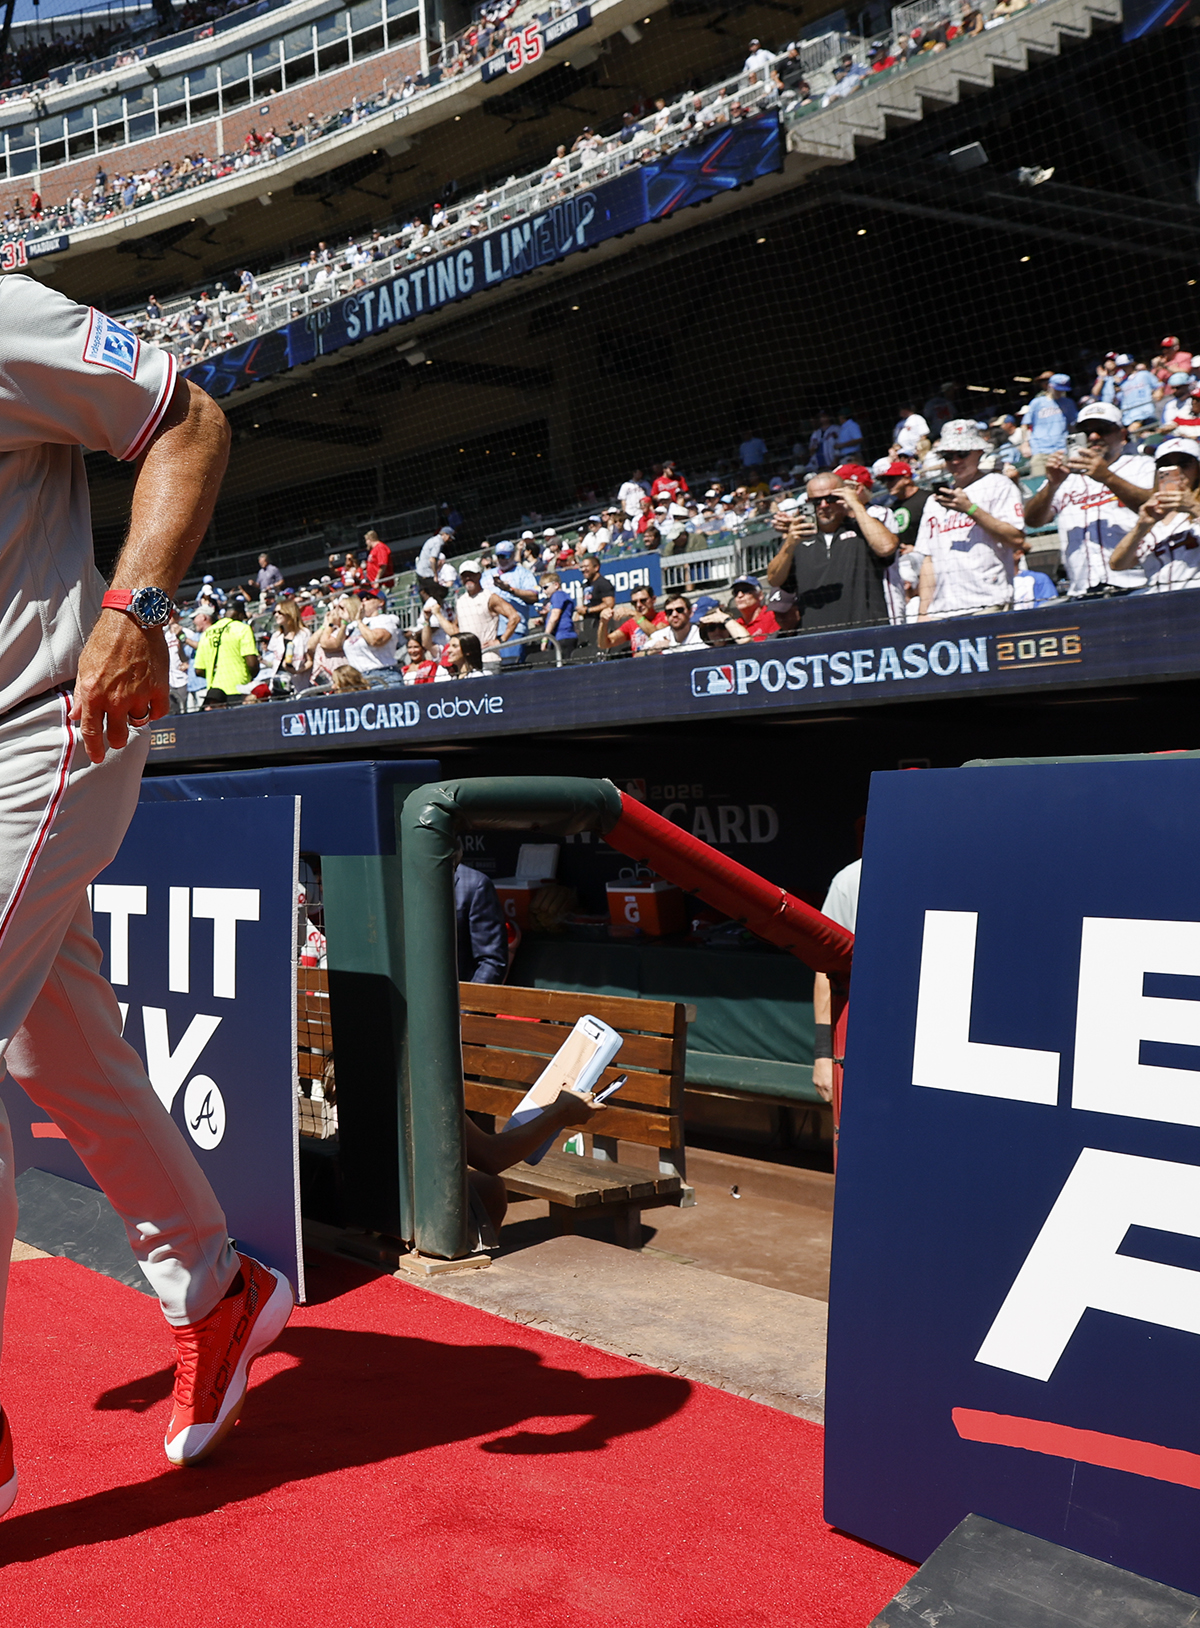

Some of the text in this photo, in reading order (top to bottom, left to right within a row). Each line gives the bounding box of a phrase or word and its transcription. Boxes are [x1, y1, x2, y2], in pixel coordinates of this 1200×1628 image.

[507, 20, 545, 75] 35
[2, 238, 28, 271] 31
[343, 250, 475, 340] STARTING
[483, 191, 598, 284] LINEUP
[102, 318, 137, 374] IBX
[927, 512, 976, 539] Phillie
[561, 567, 650, 601] HYDAI
[735, 634, 1082, 696] POSTSEASON 2026
[427, 694, 504, 719] abbvie
[150, 732, 176, 745] 2026
[650, 783, 704, 799] 2026
[503, 898, 517, 918] G
[624, 902, 640, 923] G
[86, 884, 260, 999] T IT
[116, 1001, 223, 1114] Y
[190, 1088, 218, 1135] A
